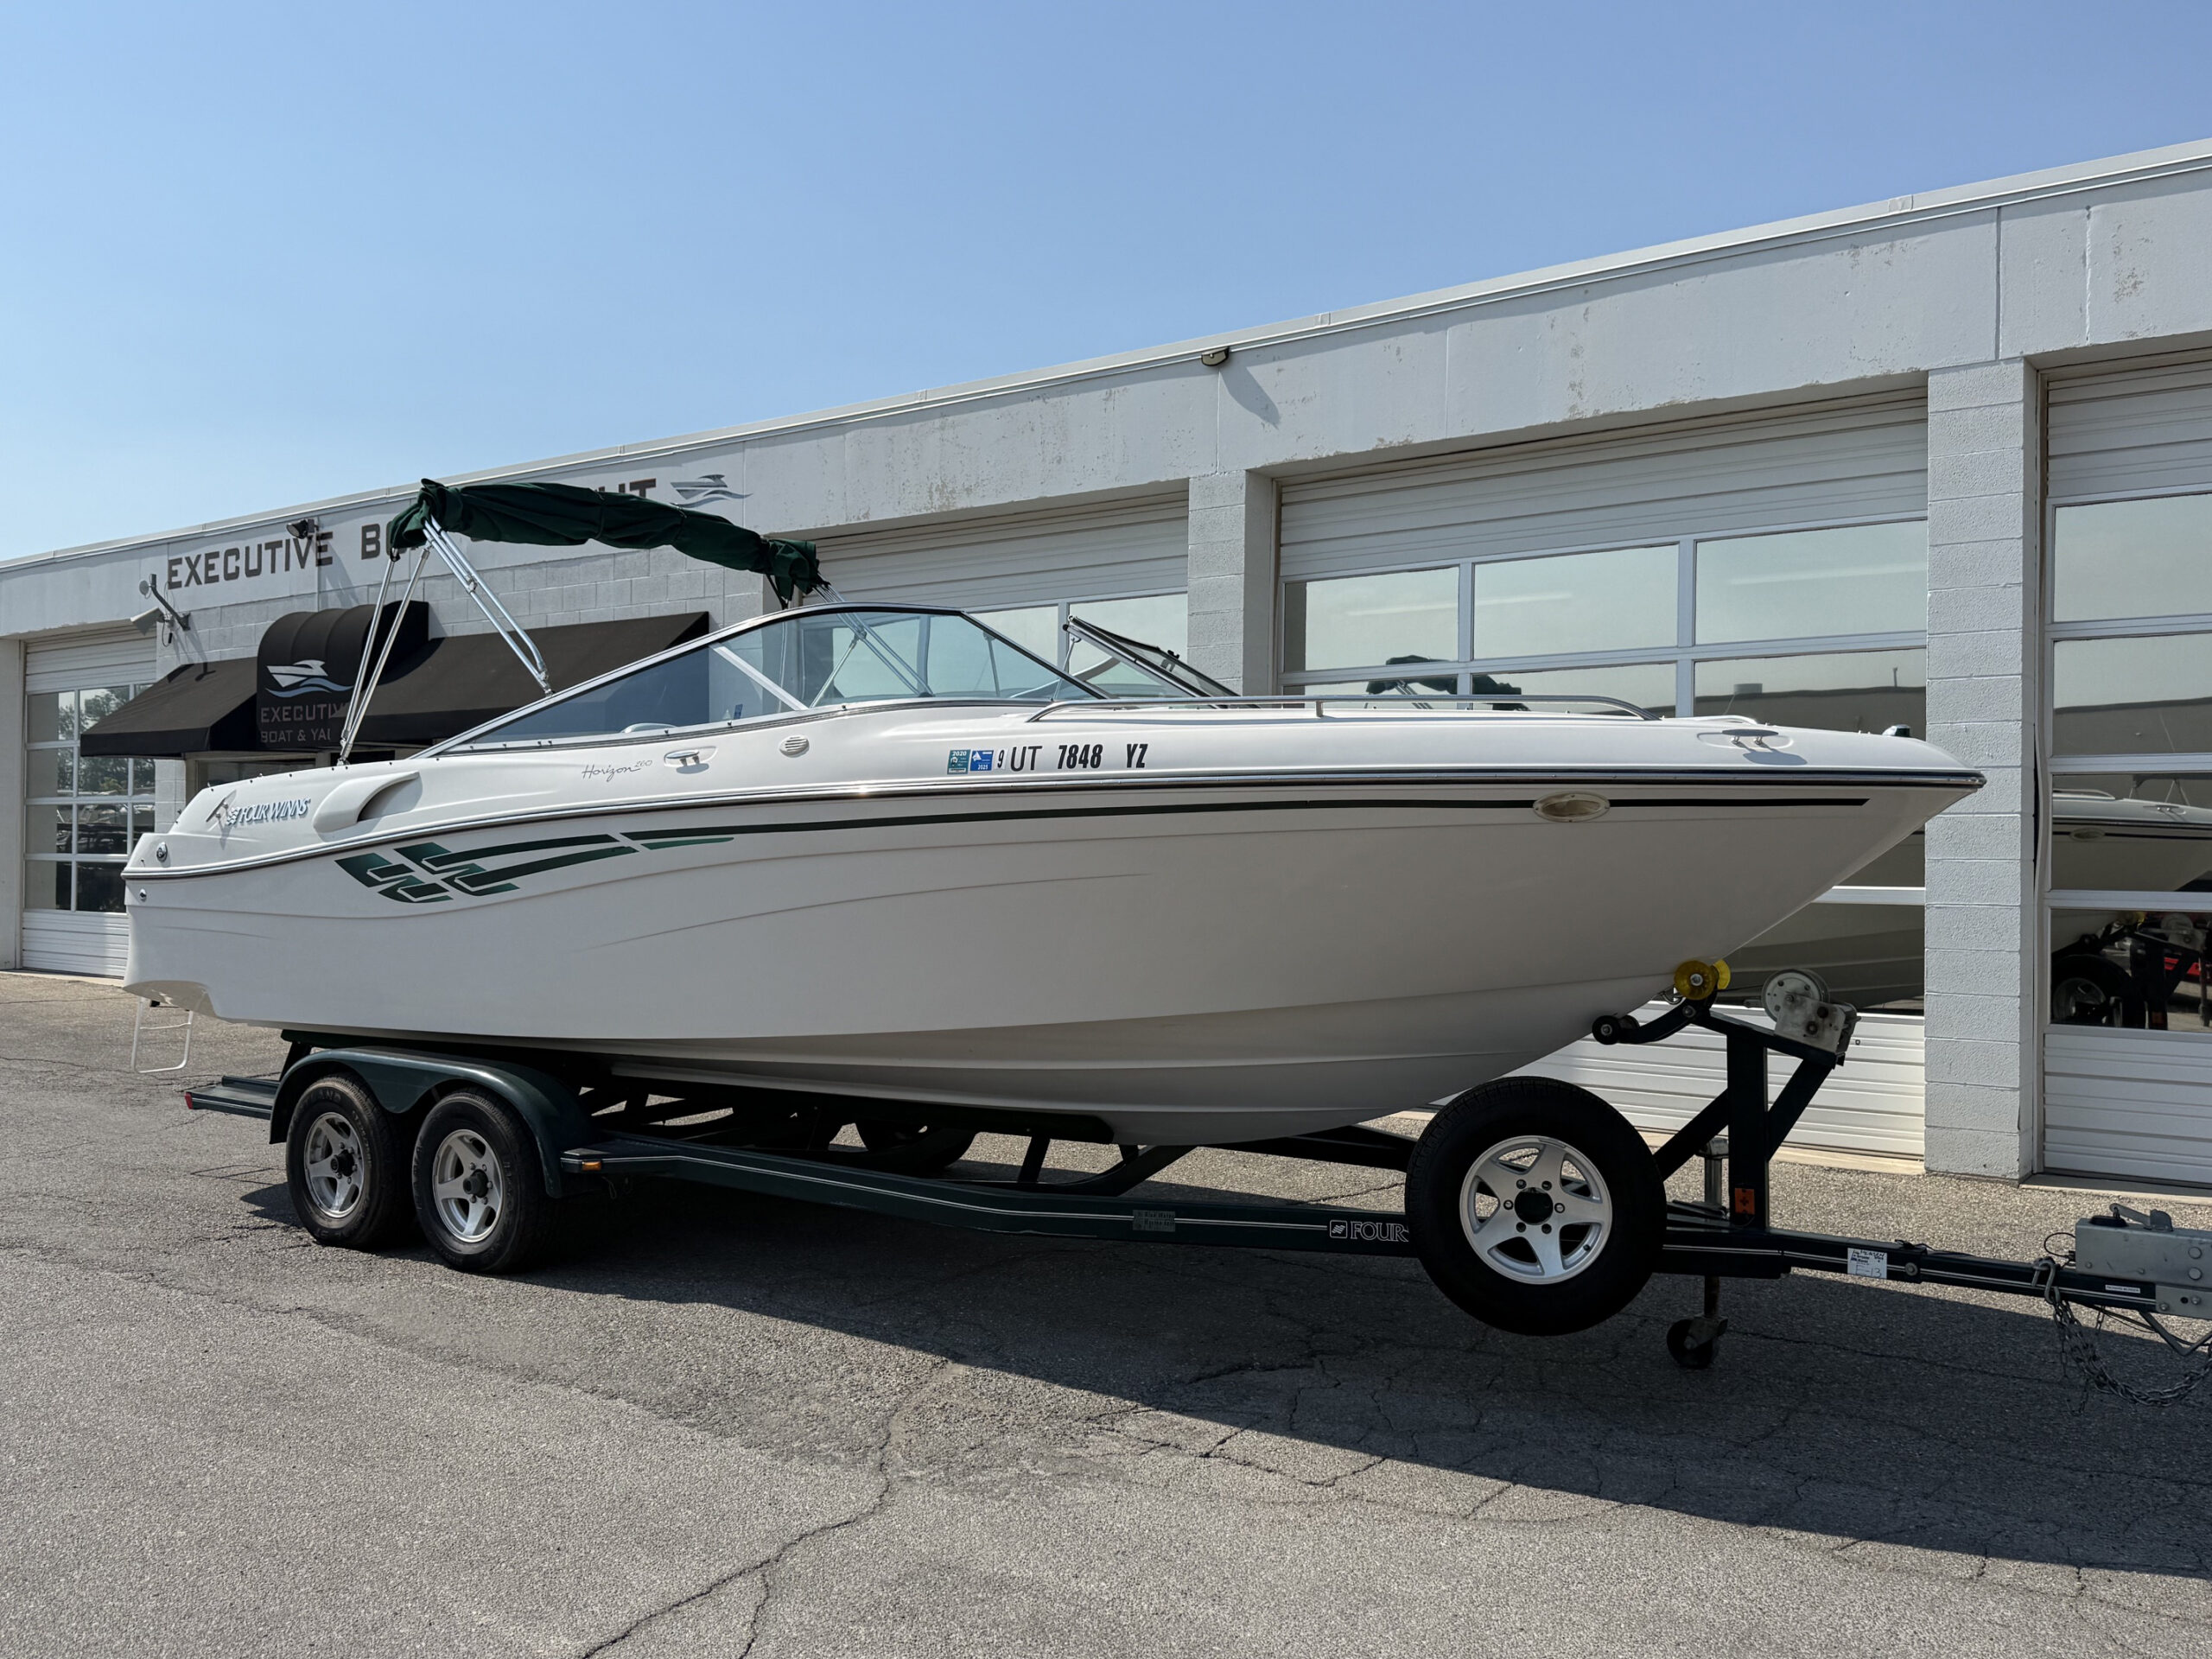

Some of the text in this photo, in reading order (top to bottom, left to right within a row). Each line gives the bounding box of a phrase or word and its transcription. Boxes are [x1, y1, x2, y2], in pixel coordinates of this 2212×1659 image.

[168, 531, 334, 590] EXECUTIVE
[260, 702, 347, 723] EXECUTI
[260, 730, 294, 743] BOAT
[297, 729, 307, 741] &
[997, 749, 1006, 769] 9
[1010, 743, 1148, 772] UT 7848 YZ
[582, 764, 642, 783] Horizon
[1350, 1220, 1409, 1243] FOUR
